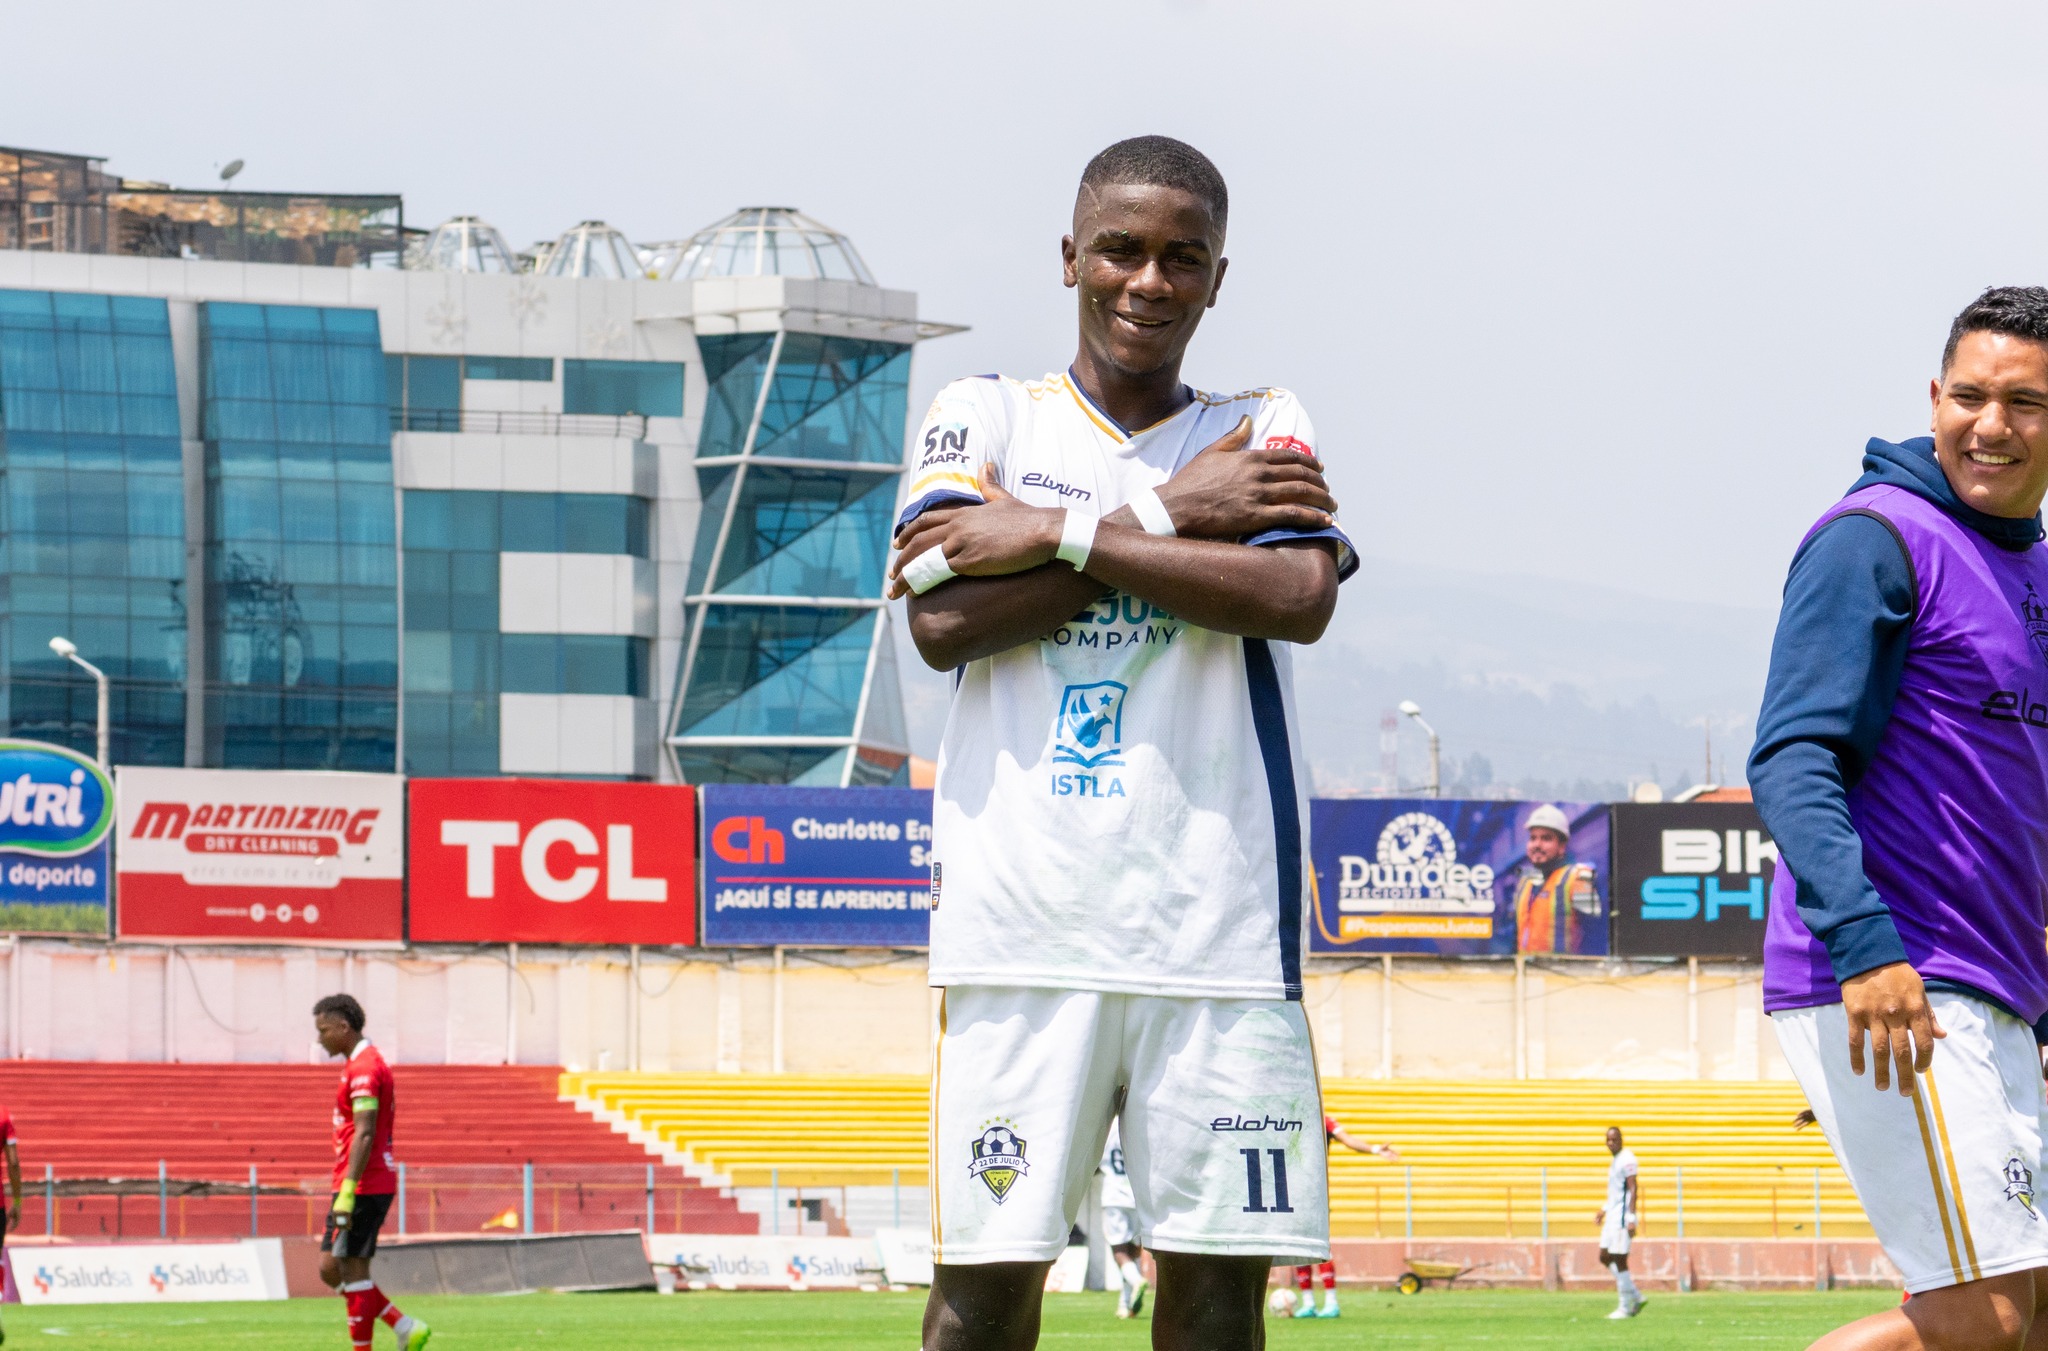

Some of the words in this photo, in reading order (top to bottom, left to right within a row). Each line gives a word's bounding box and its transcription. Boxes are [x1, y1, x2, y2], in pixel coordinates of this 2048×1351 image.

[919, 452, 970, 471] MART
[1040, 625, 1178, 649] OMPANY
[1051, 774, 1126, 798] ISTLA
[712, 816, 785, 864] Ch
[792, 817, 900, 840] Charlotte
[205, 835, 236, 851] DRY
[241, 837, 320, 854] CLEANING
[441, 818, 667, 902] TCL
[9, 862, 96, 891] deporte
[1339, 855, 1494, 890] Dundee
[715, 885, 771, 912] ¡AQUÍ
[773, 885, 792, 909] SÍ
[795, 889, 818, 909] SE
[821, 890, 907, 910] APRENDE
[1641, 876, 1774, 922] SH
[1210, 1114, 1302, 1131] elohim
[989, 1157, 998, 1165] DE
[1000, 1157, 1020, 1166] JULIO
[1240, 1149, 1294, 1212] 11
[54, 1265, 133, 1289] Saludsa
[170, 1263, 250, 1287] Saludsa
